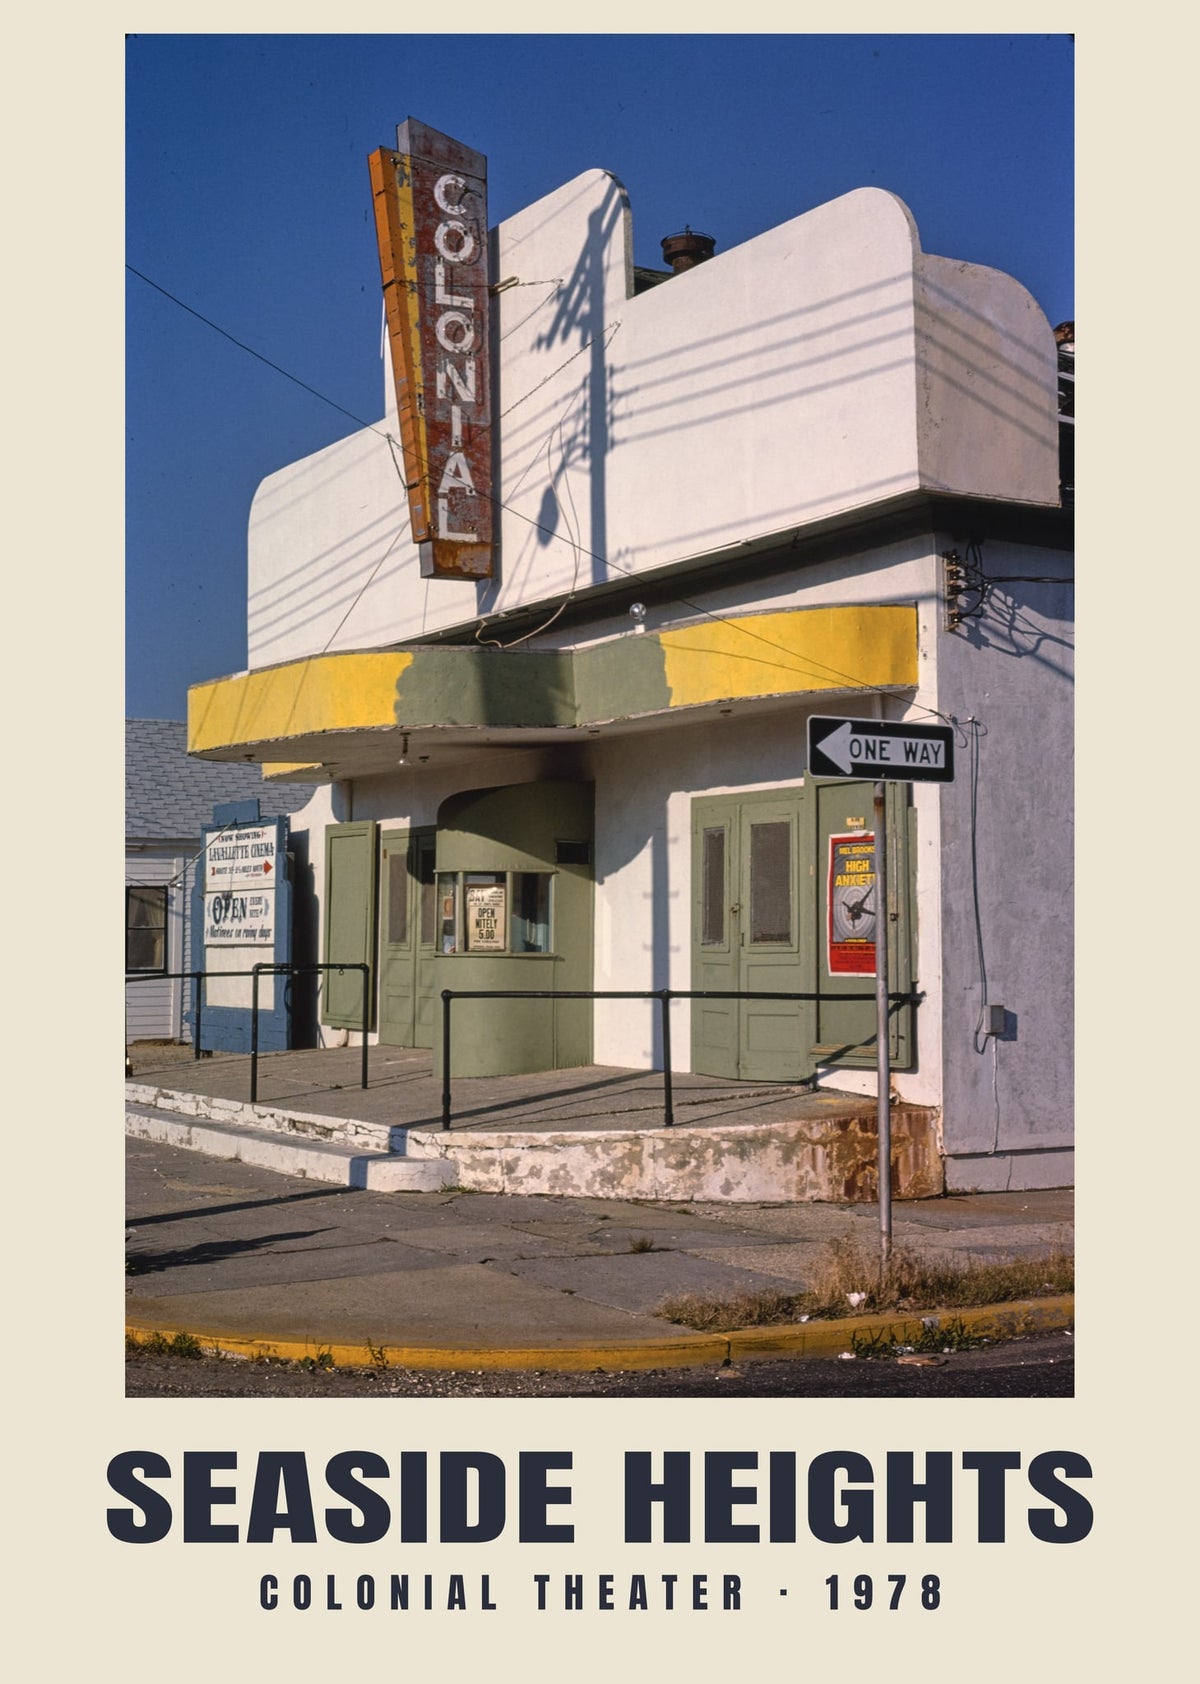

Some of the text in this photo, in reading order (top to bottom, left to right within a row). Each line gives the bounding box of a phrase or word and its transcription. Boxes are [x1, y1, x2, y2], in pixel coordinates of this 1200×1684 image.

[433, 173, 478, 541] COLONIAL
[849, 738, 942, 764] ONE WAY
[251, 842, 274, 858] CINEMA
[845, 860, 869, 872] HIGH
[213, 896, 247, 924] OPEN
[478, 908, 496, 918] OPEN
[475, 918, 498, 929] NITELY
[210, 925, 234, 938] Matinees
[258, 924, 272, 941] days
[478, 929, 495, 940] 5.00
